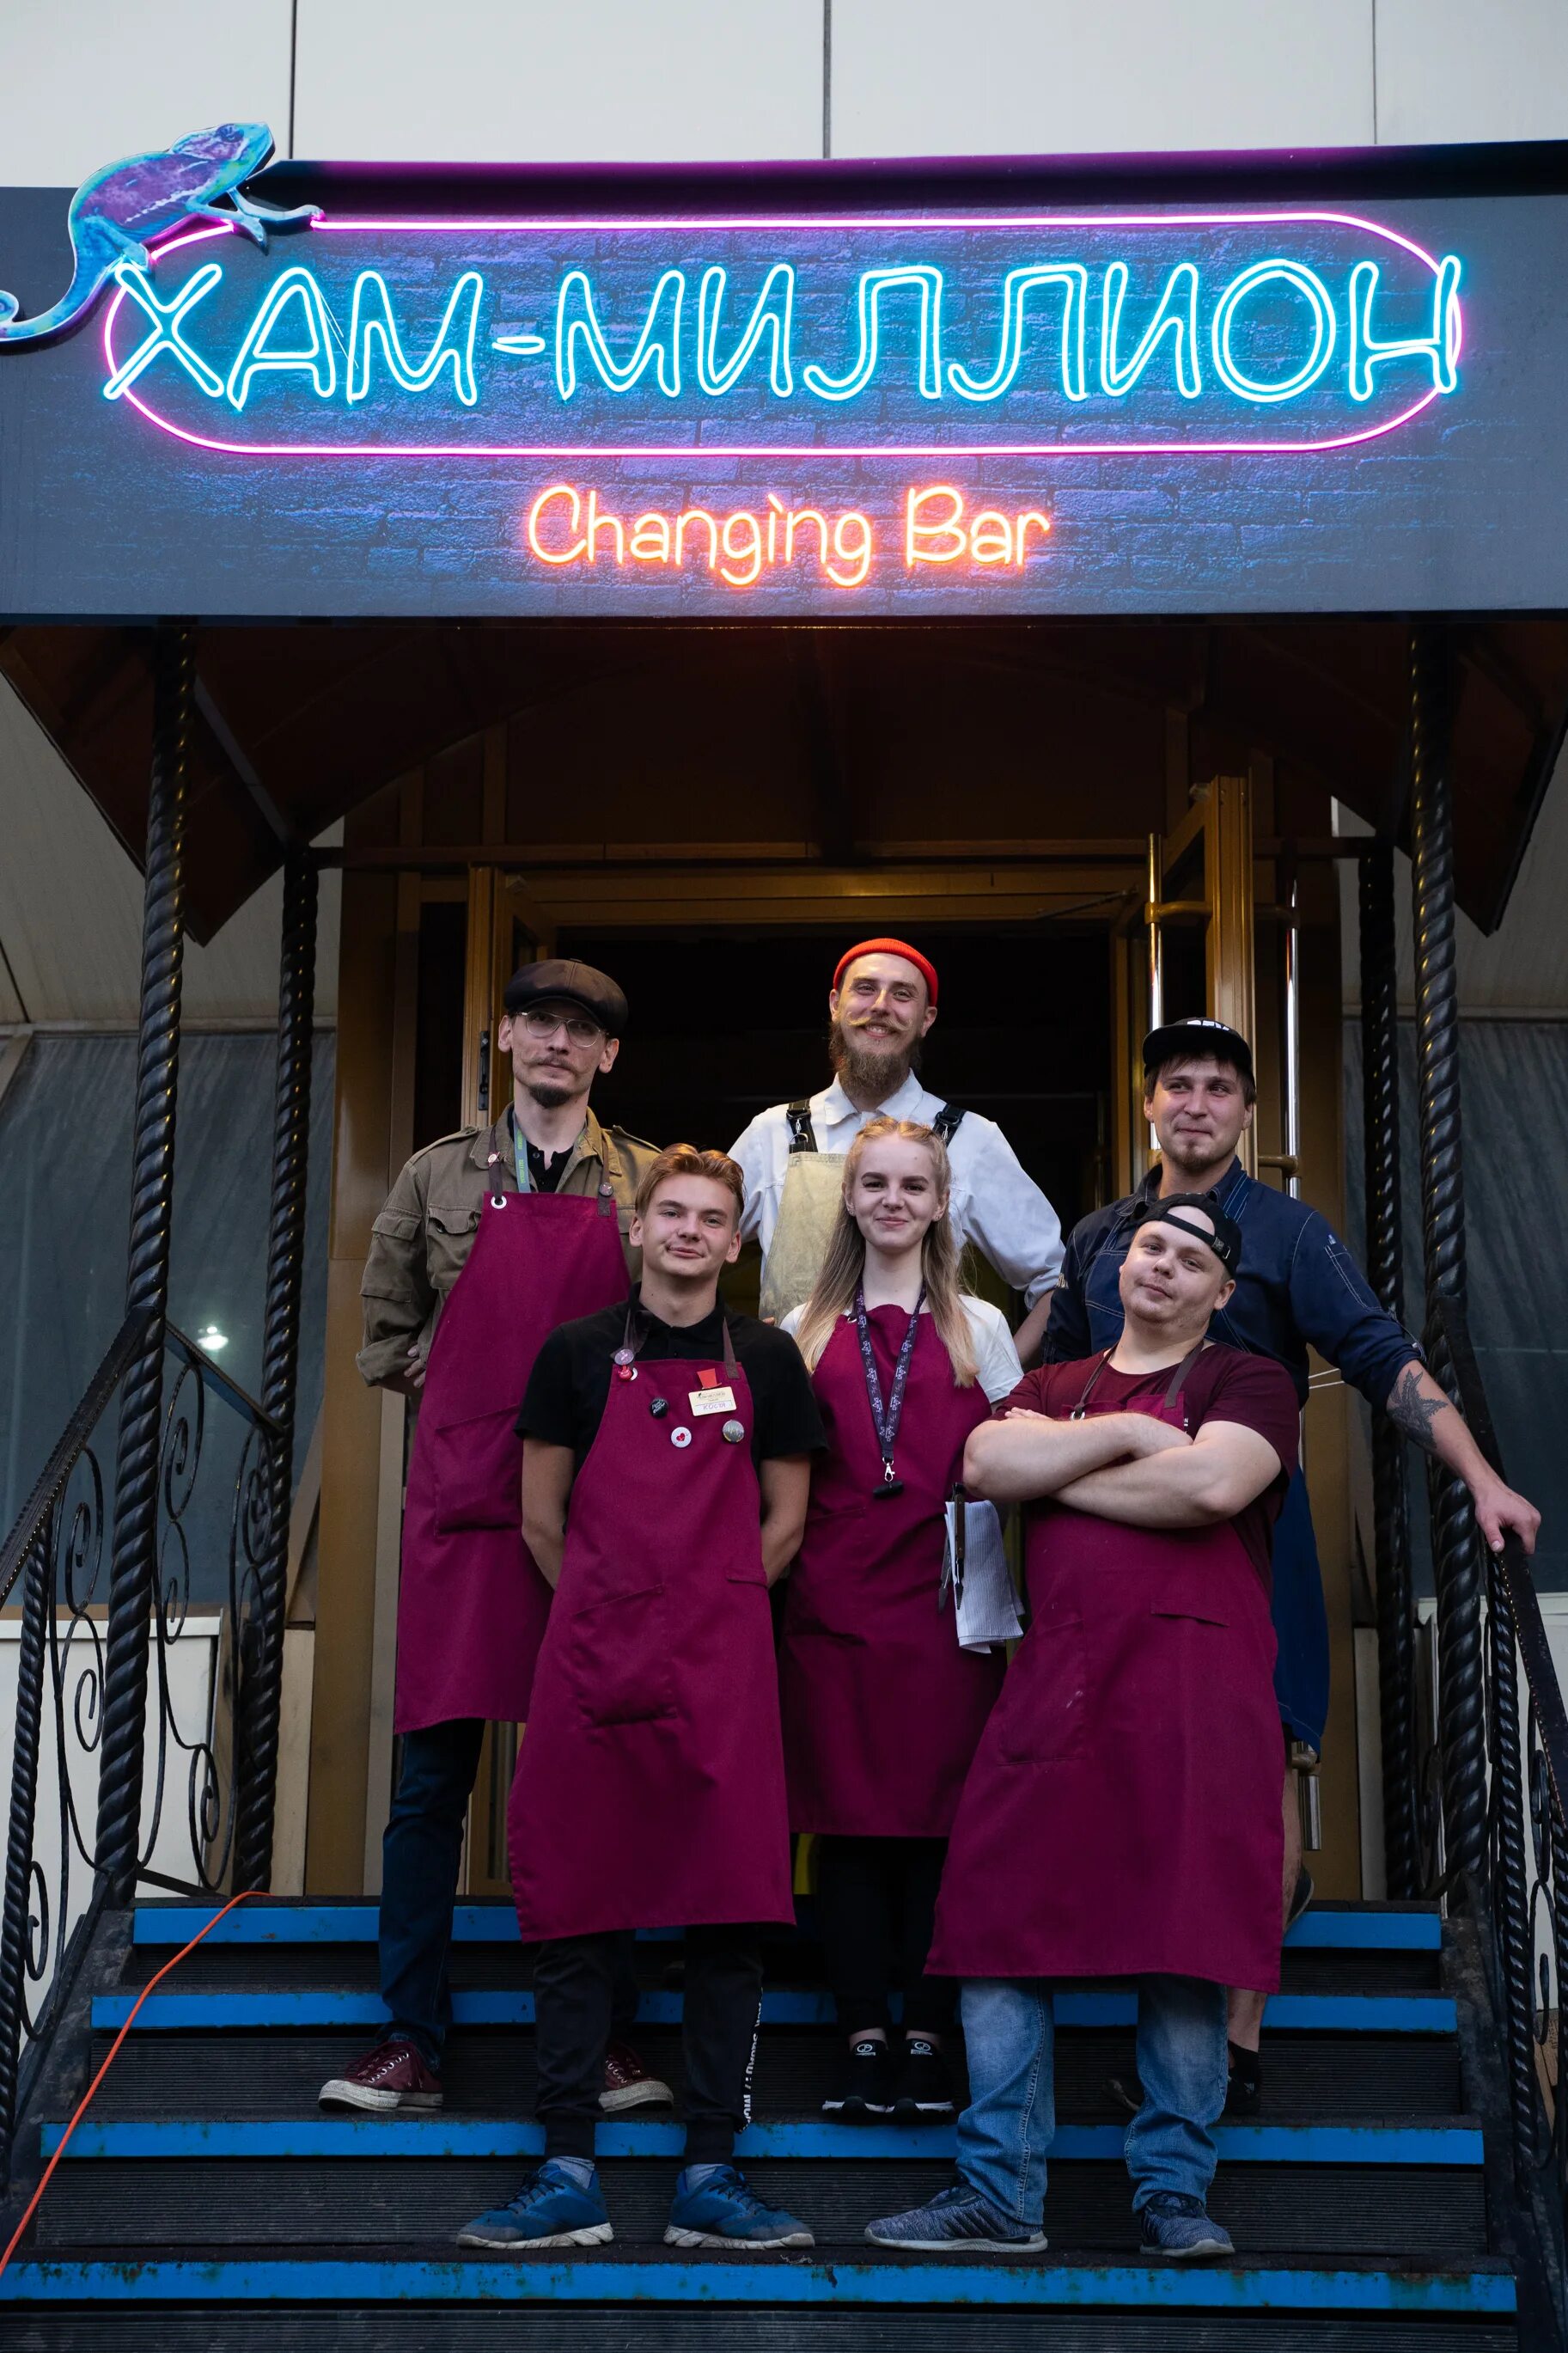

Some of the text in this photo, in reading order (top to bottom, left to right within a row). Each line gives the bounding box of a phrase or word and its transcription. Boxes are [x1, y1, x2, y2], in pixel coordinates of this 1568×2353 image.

[102, 254, 1461, 410] ХАМ-МИЛЛИОН
[527, 483, 1052, 588] Changing Bar
